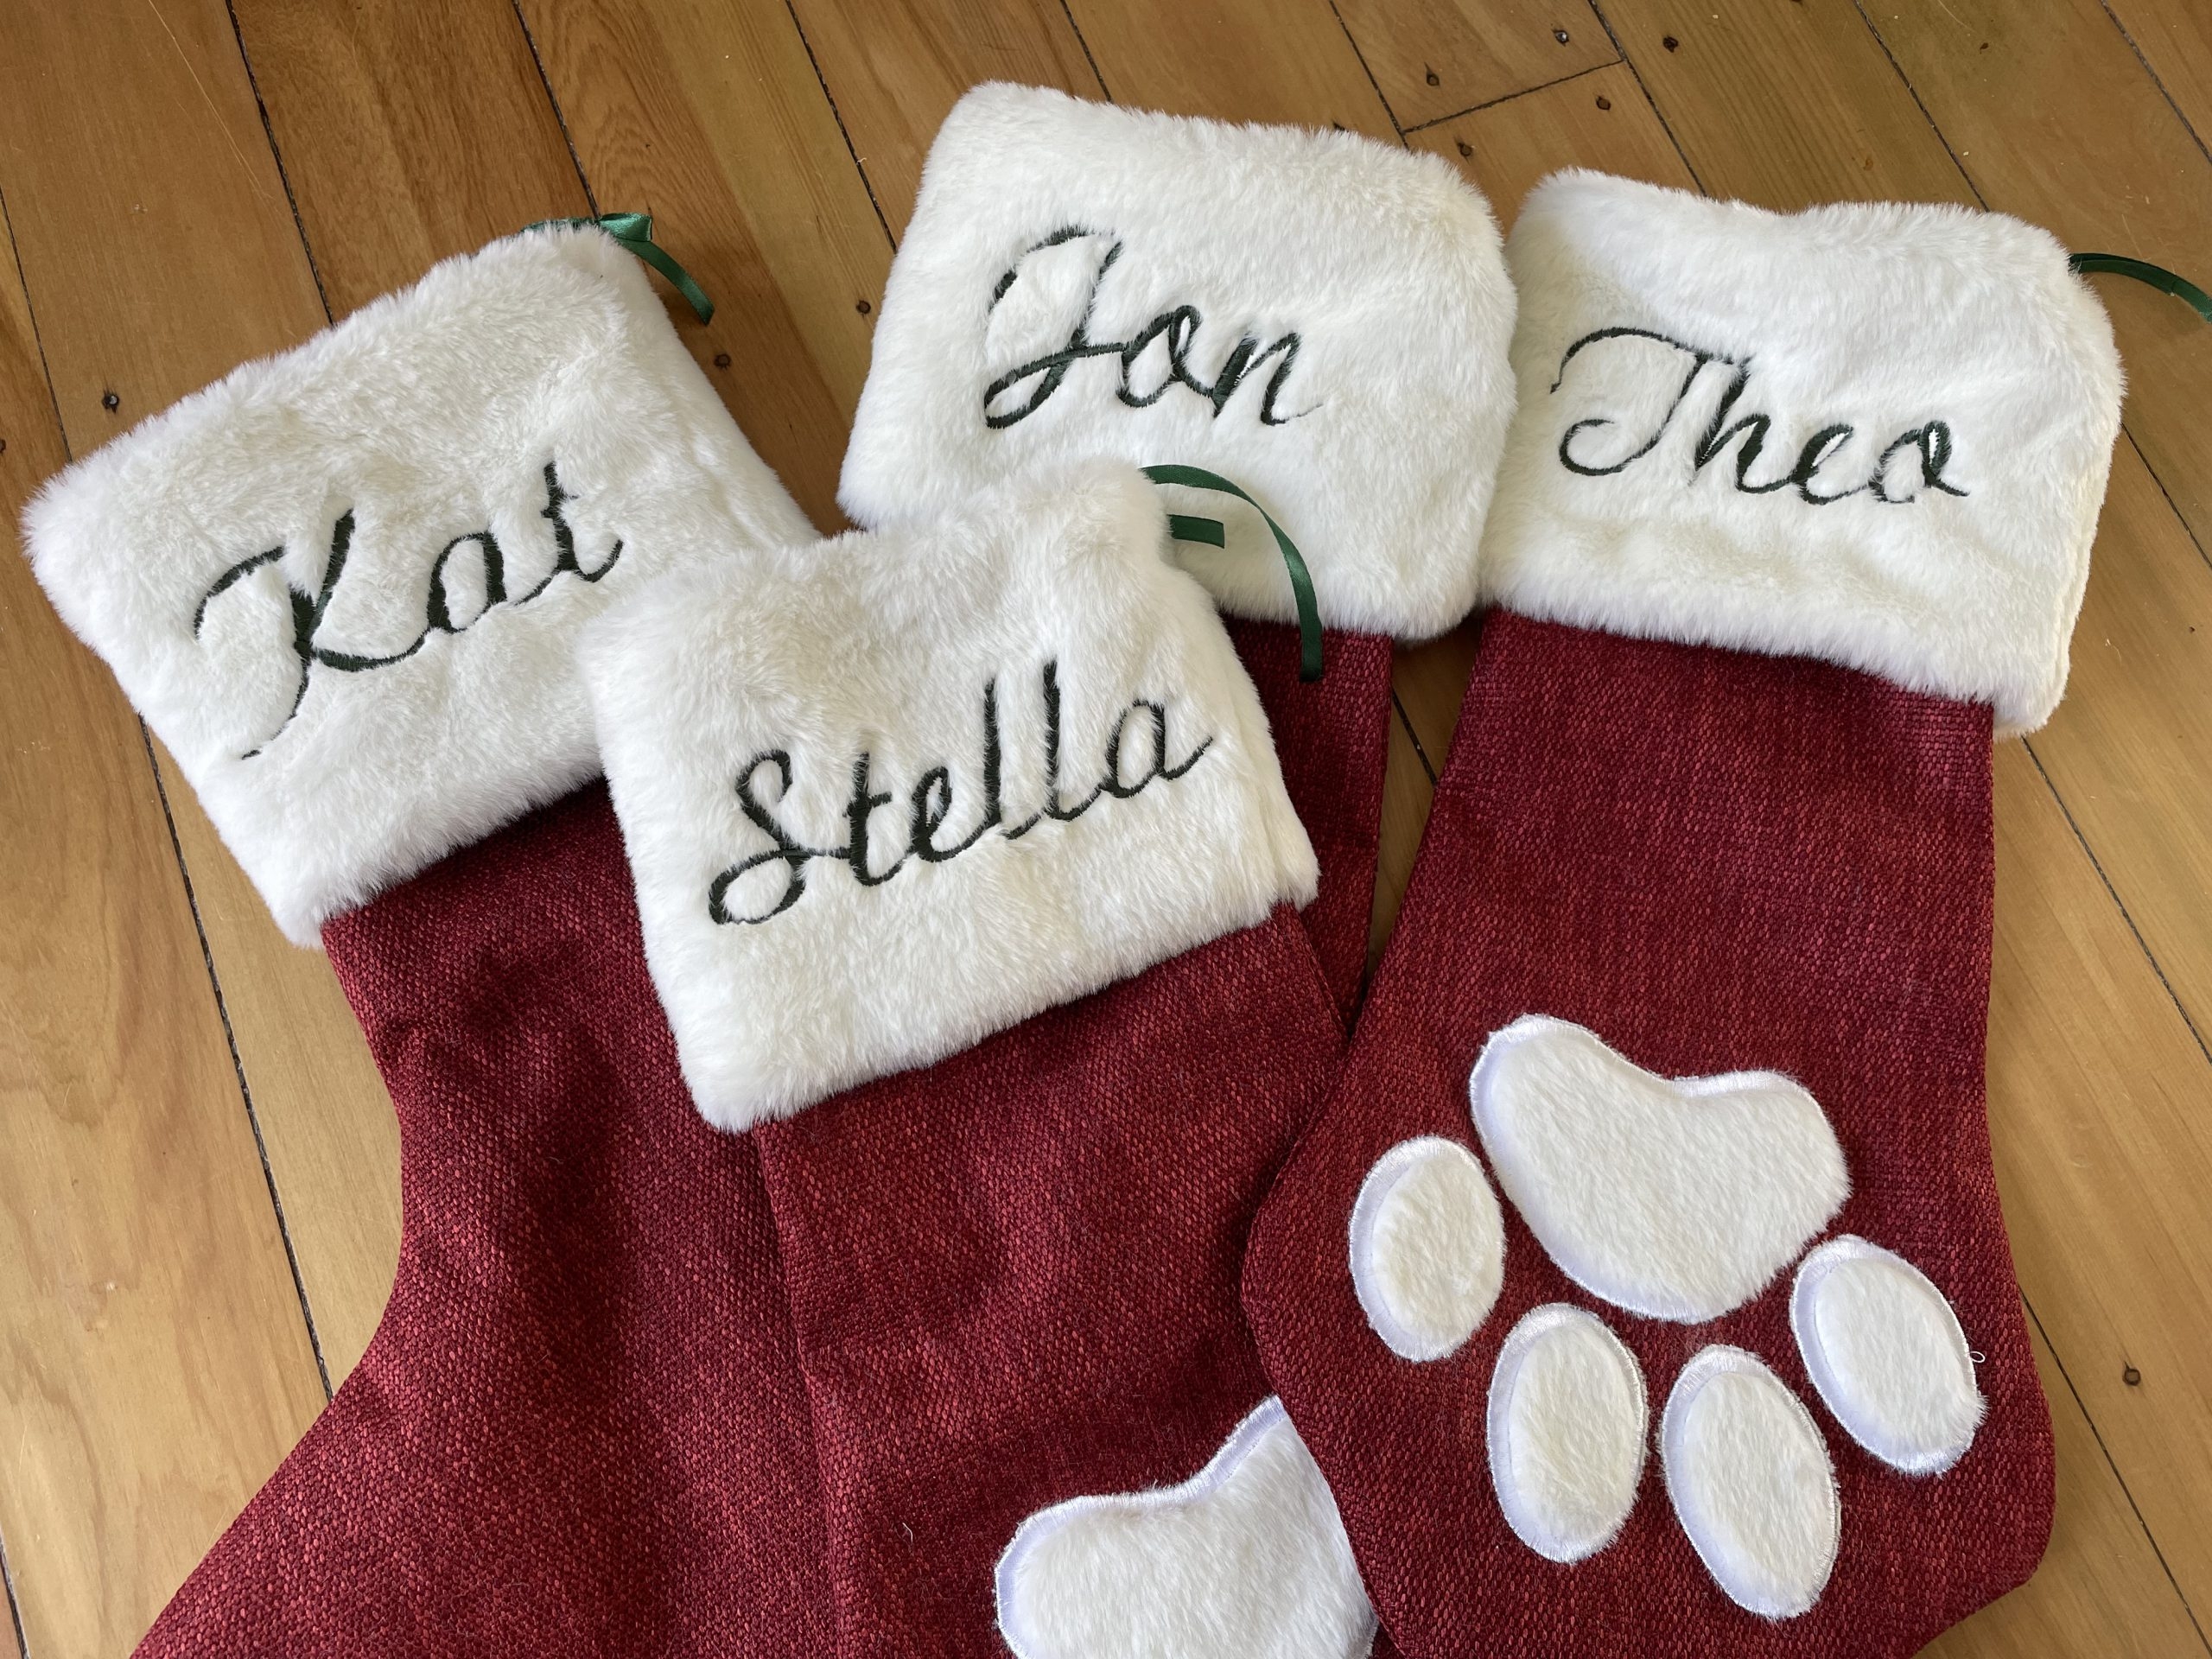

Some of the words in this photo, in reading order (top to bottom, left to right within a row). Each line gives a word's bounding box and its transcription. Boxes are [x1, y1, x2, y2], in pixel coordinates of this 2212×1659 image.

[983, 225, 1322, 429] Jon
[1550, 327, 1969, 505] Theo
[194, 460, 623, 760] Kat
[709, 658, 1213, 925] Stella
